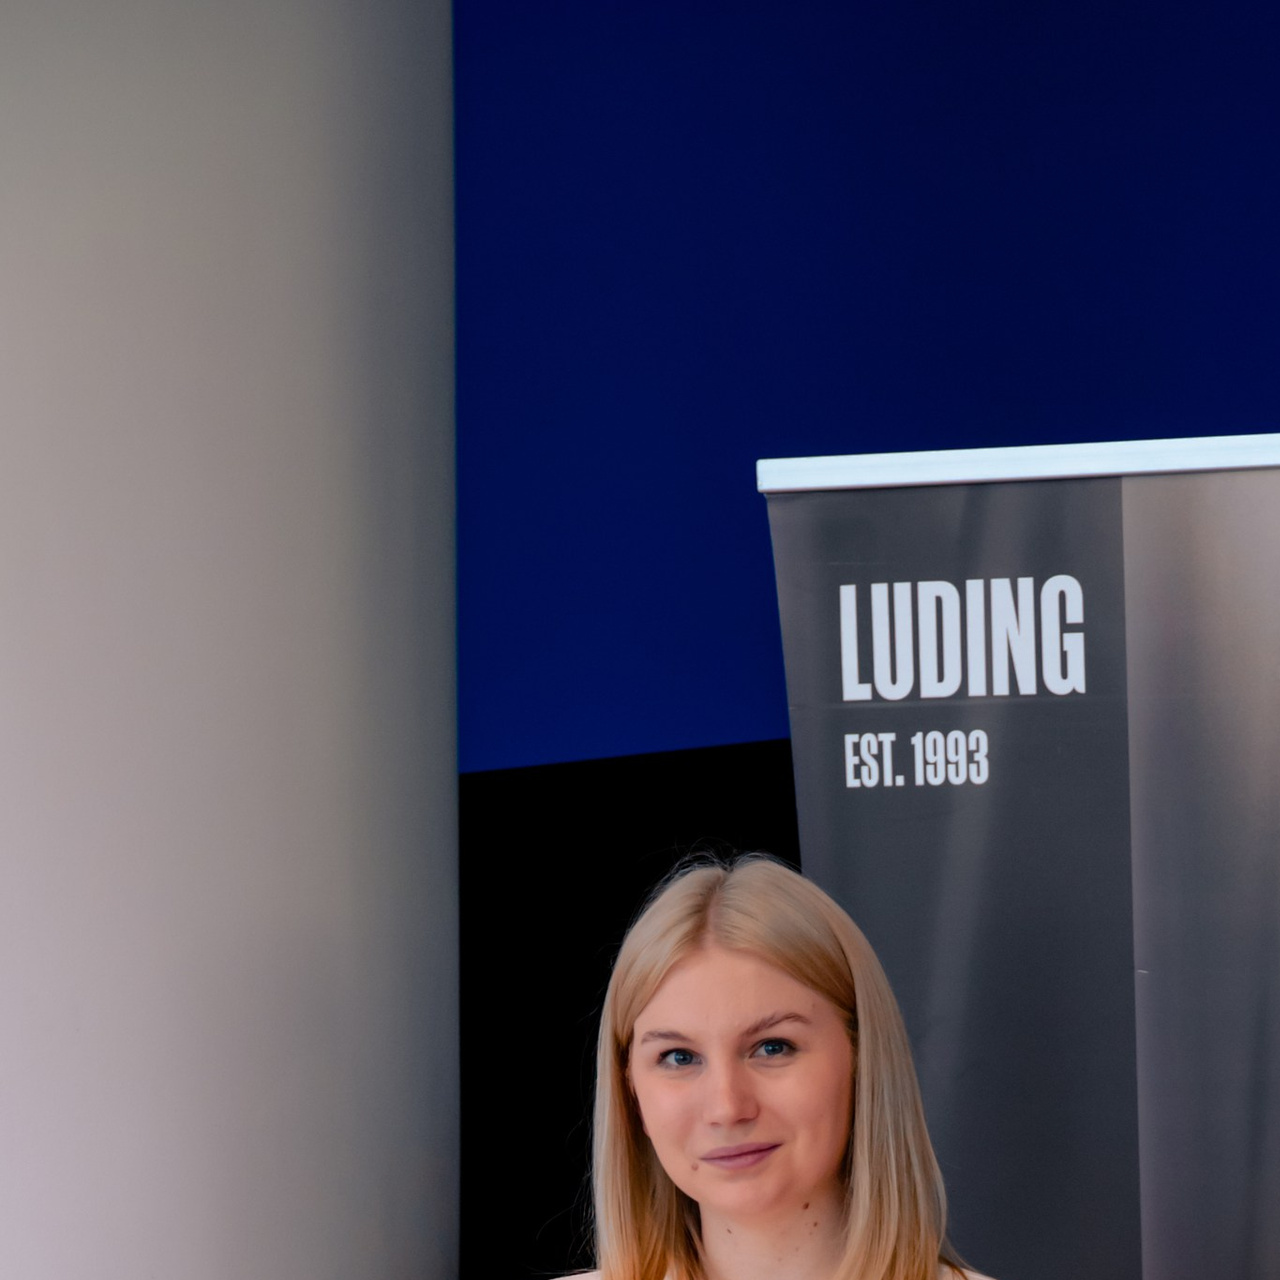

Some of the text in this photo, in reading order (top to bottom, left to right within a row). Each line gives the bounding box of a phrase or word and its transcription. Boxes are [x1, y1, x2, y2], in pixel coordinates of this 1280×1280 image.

[839, 574, 1086, 701] LUDING
[844, 729, 989, 788] EST. 1993
